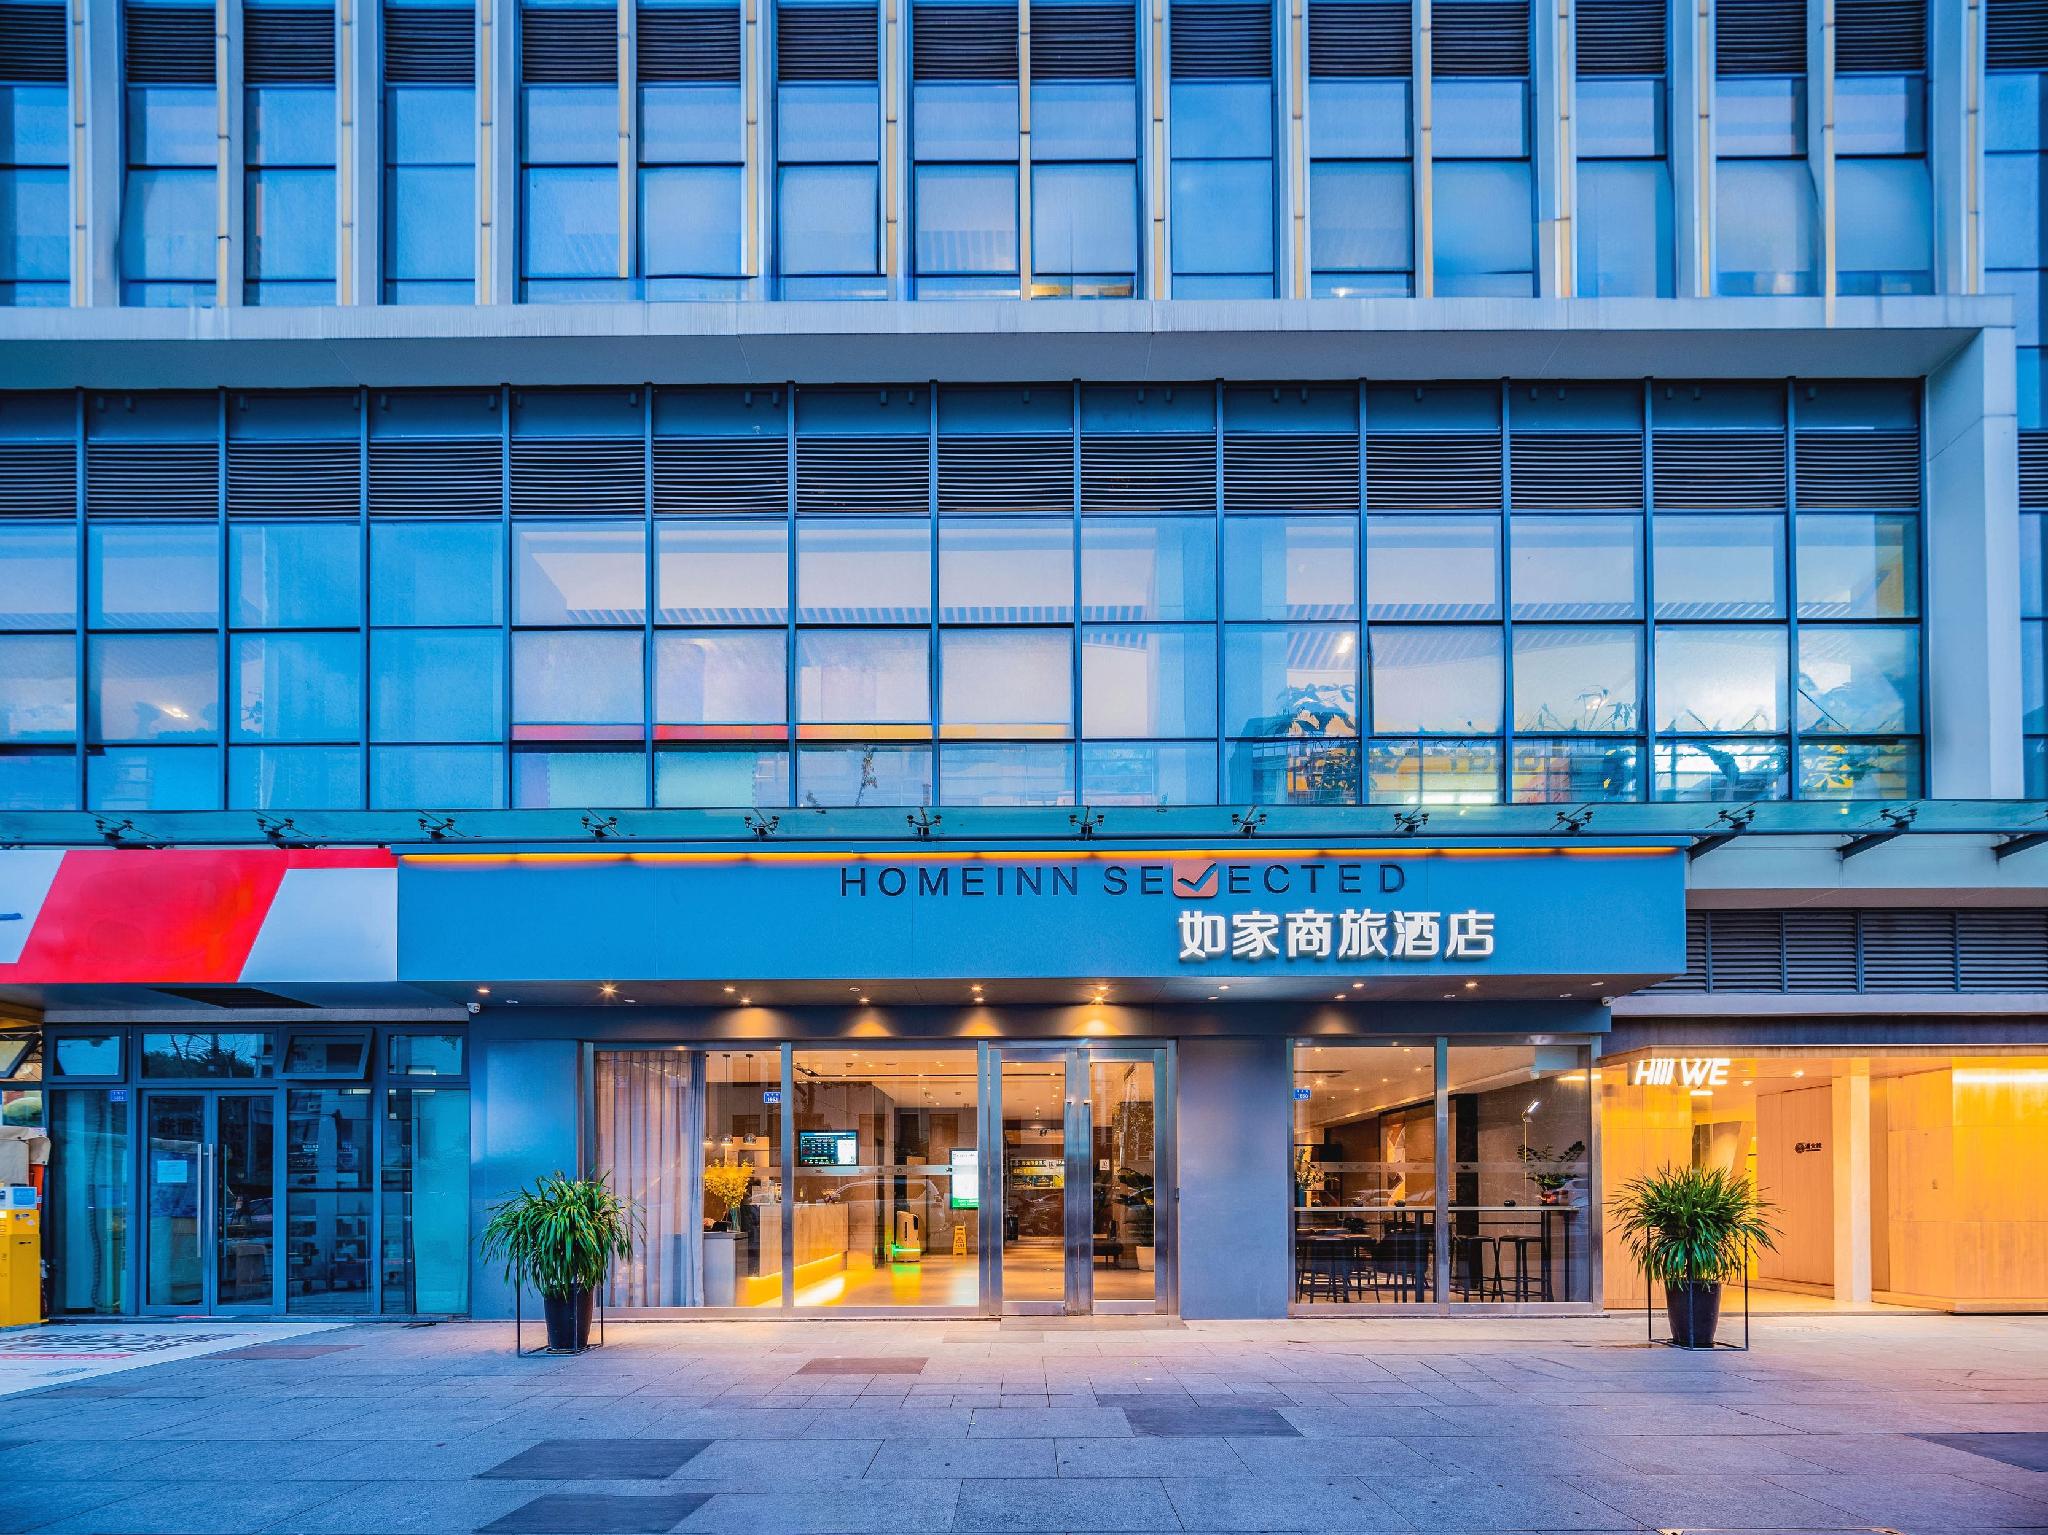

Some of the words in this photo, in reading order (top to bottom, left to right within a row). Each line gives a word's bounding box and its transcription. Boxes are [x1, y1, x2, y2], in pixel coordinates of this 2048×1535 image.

[840, 866, 1078, 897] HOMEINN
[1102, 862, 1407, 898] SEECTED
[1178, 908, 1496, 960] 如家商旅酒店
